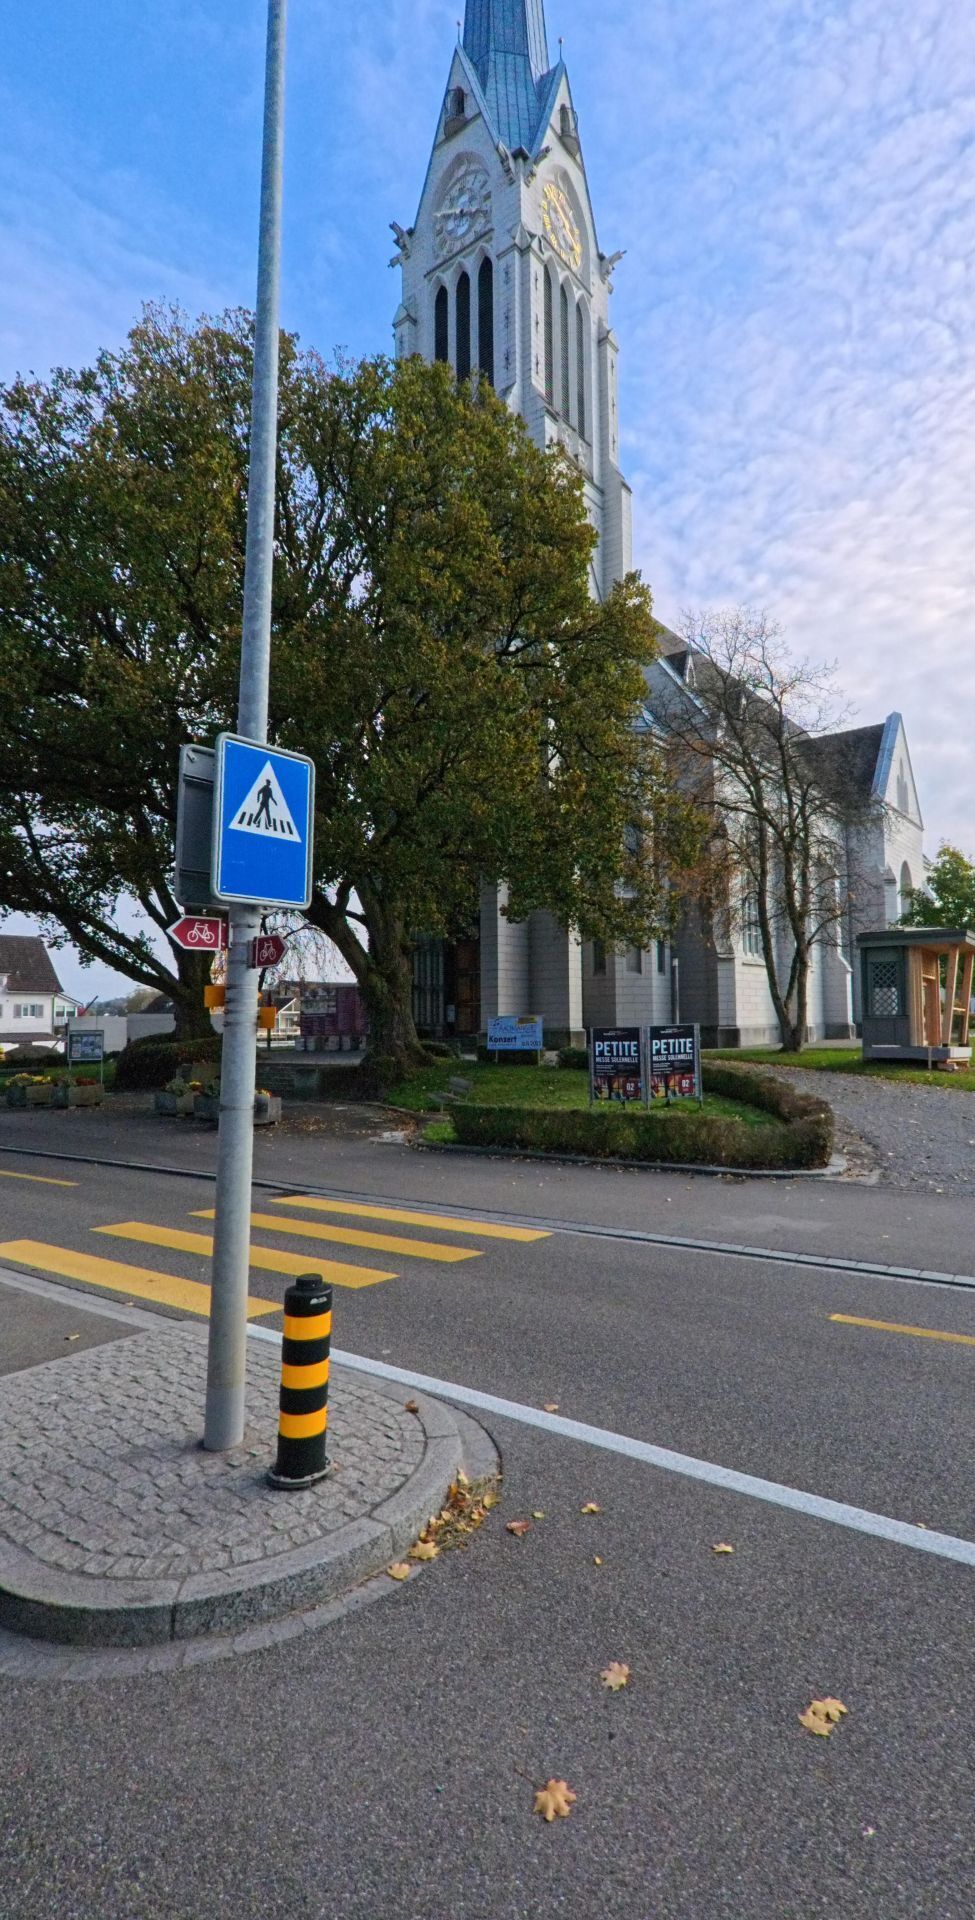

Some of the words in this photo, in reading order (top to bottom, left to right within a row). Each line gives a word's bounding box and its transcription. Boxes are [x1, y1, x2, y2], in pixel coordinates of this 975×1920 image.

[489, 1035, 516, 1043] Konzert
[595, 1041, 638, 1056] PETITE
[652, 1038, 693, 1054] PETITE
[626, 1083, 635, 1091] 02
[681, 1079, 690, 1087] 02
